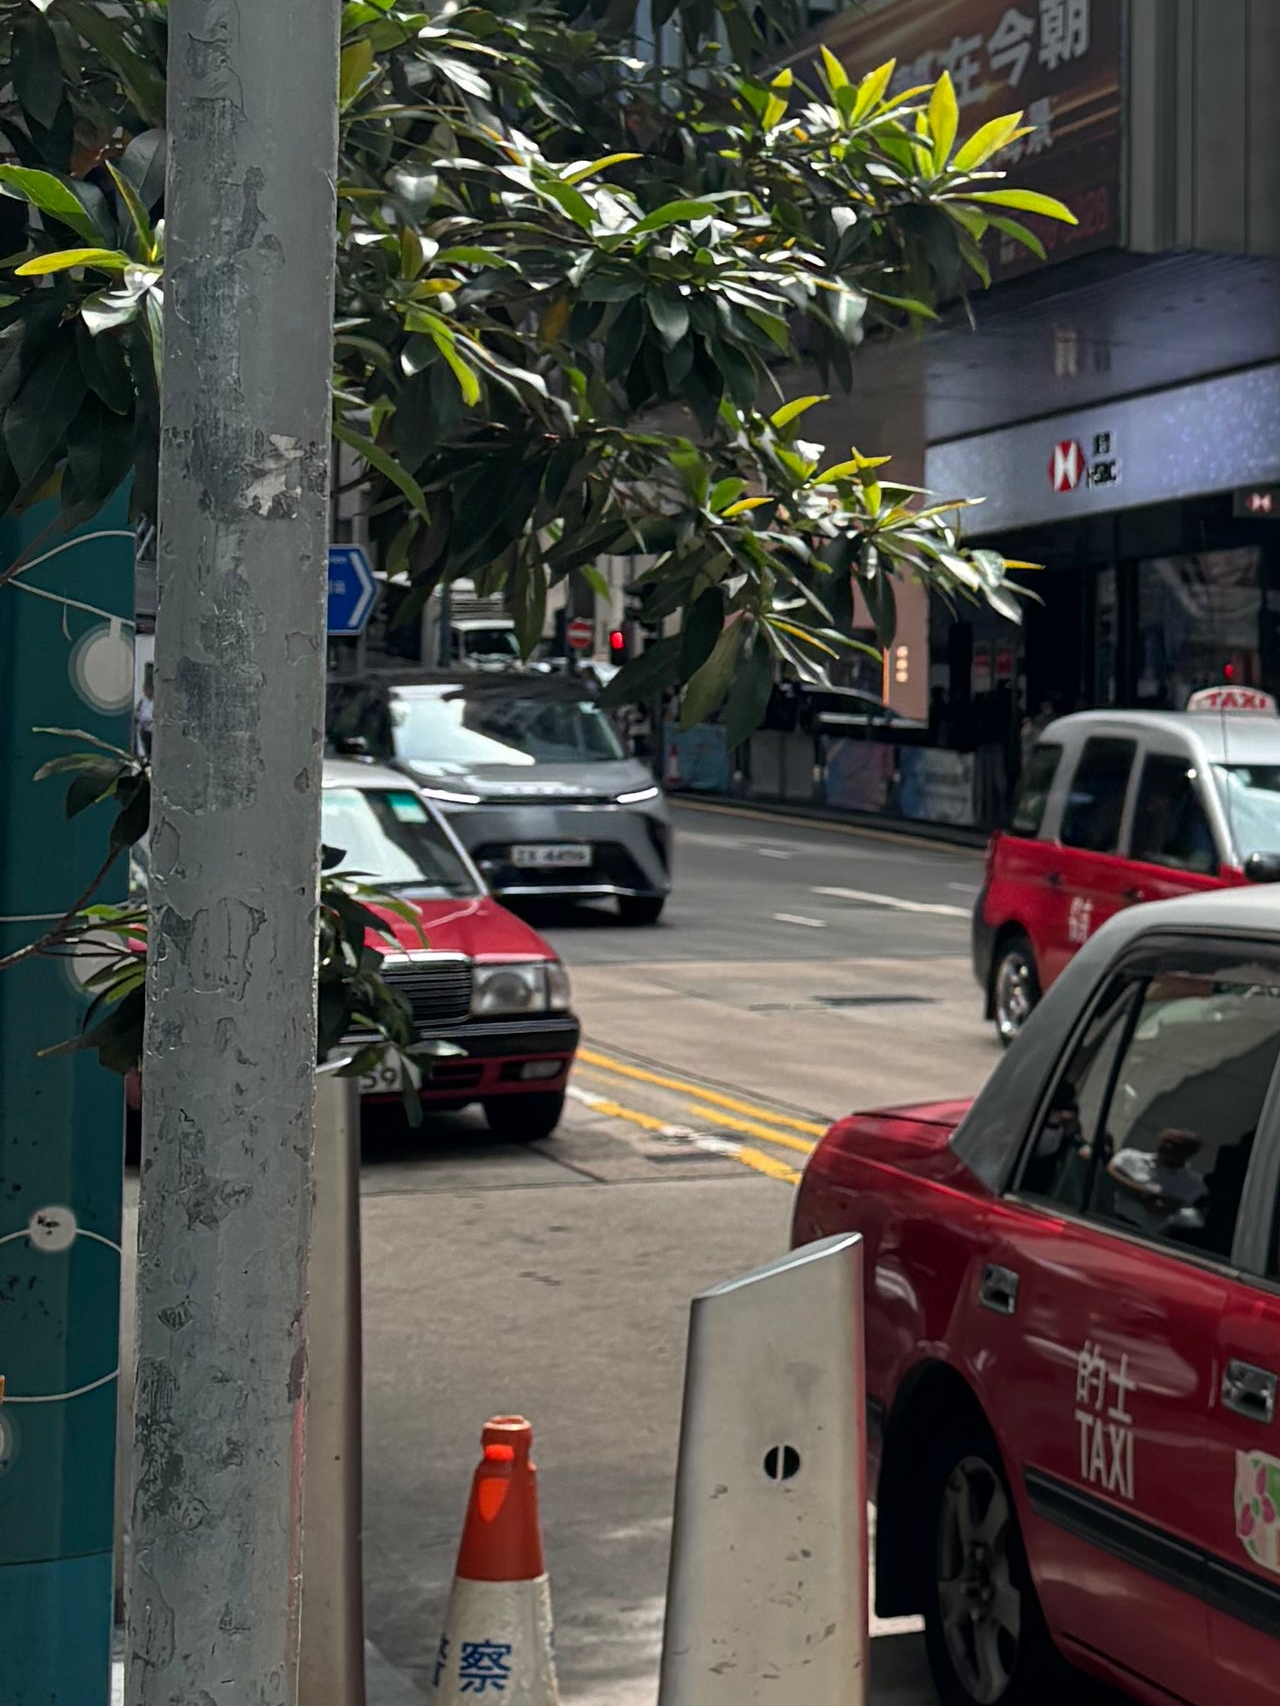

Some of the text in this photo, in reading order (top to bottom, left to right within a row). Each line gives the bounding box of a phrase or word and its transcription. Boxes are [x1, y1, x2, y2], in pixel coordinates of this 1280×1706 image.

[1208, 692, 1267, 709] TAXI
[1076, 1339, 1137, 1425] 的士
[1074, 1407, 1135, 1501] TAXI
